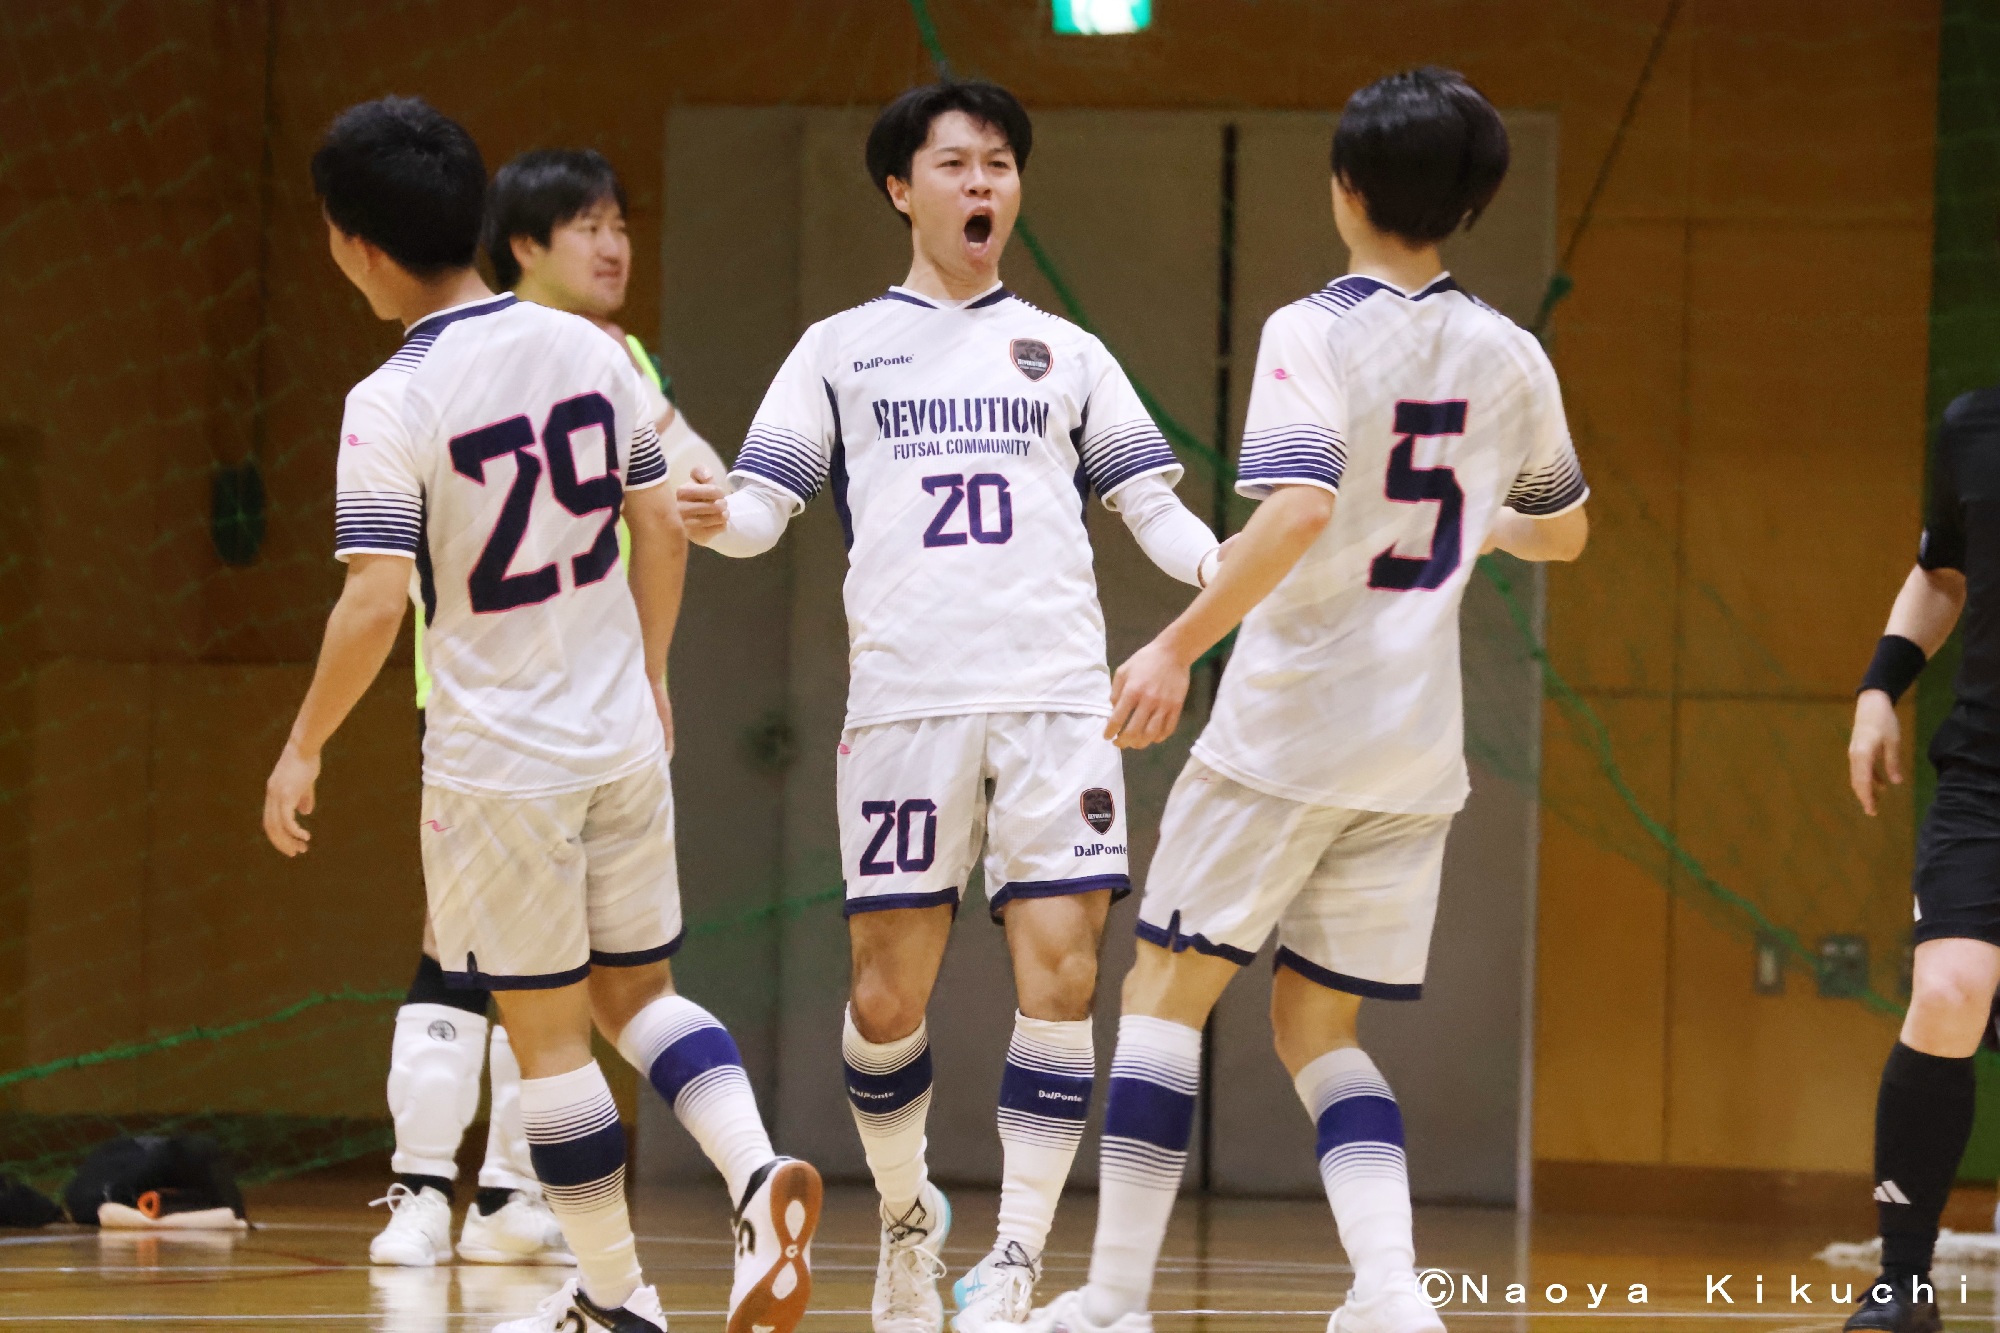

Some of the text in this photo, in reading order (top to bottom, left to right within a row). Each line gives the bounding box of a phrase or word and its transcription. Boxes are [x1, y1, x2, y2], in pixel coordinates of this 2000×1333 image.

[853, 354, 914, 373] DalPonte
[872, 396, 1050, 441] REVOLUTION
[893, 439, 1031, 460] FUTSAL COMMUNITY
[448, 390, 625, 615] 29
[921, 473, 1013, 548] 20
[1366, 399, 1469, 592] 5
[859, 799, 938, 877] 20
[1038, 1089, 1083, 1102] DalPonte
